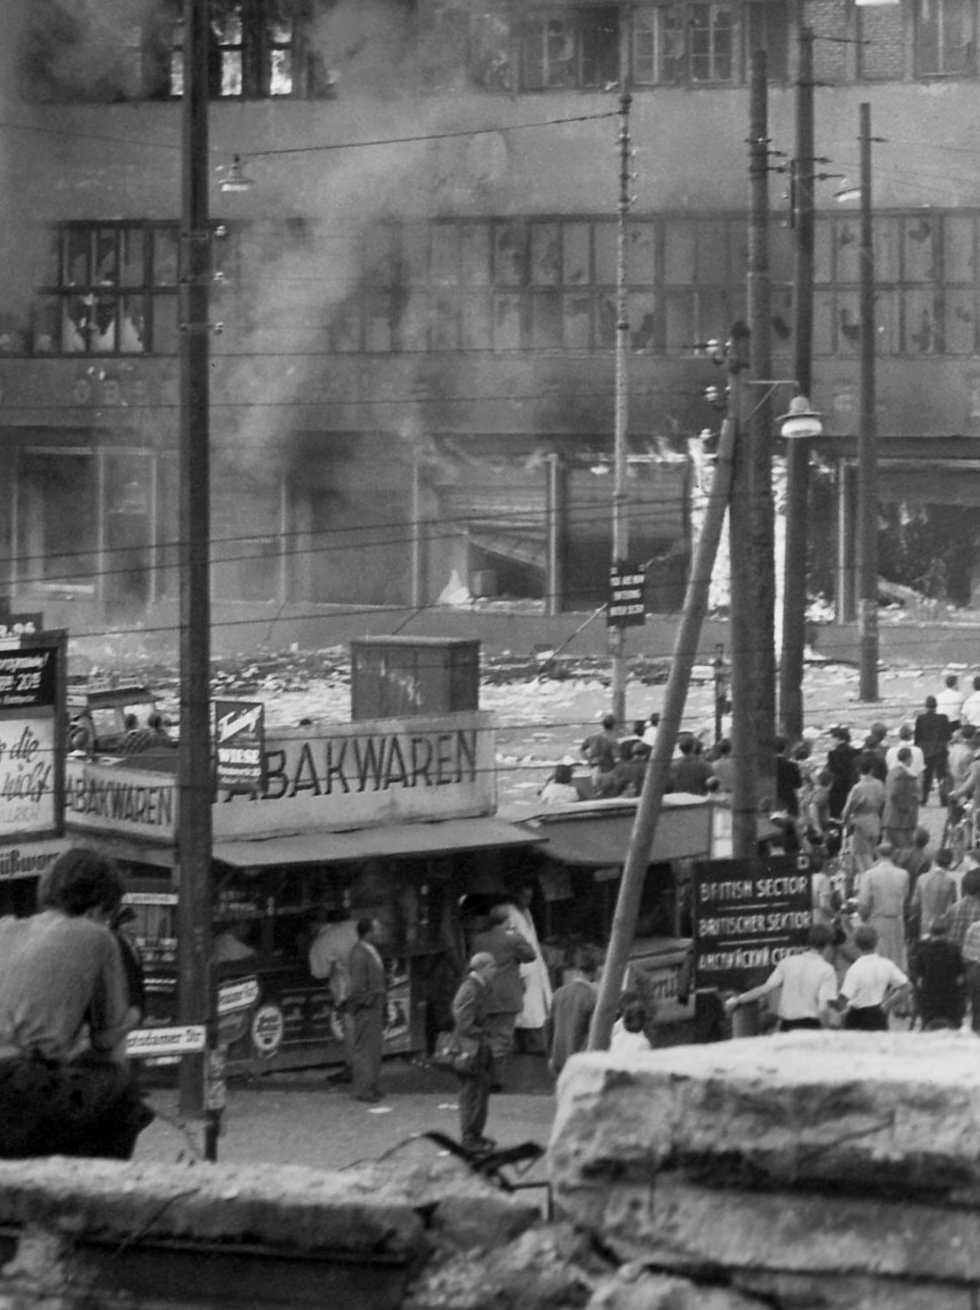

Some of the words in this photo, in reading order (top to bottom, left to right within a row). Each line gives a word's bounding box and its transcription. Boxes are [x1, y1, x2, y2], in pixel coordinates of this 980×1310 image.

[9, 725, 39, 763] die
[0, 760, 52, 804] nicht
[65, 775, 173, 827] ABAKWAREN
[699, 880, 753, 903] BRITISH
[755, 874, 808, 898] SECTOR
[699, 914, 766, 938] BRITISCHER
[766, 910, 813, 933] SEKTOR
[125, 1030, 182, 1049] otsdamer
